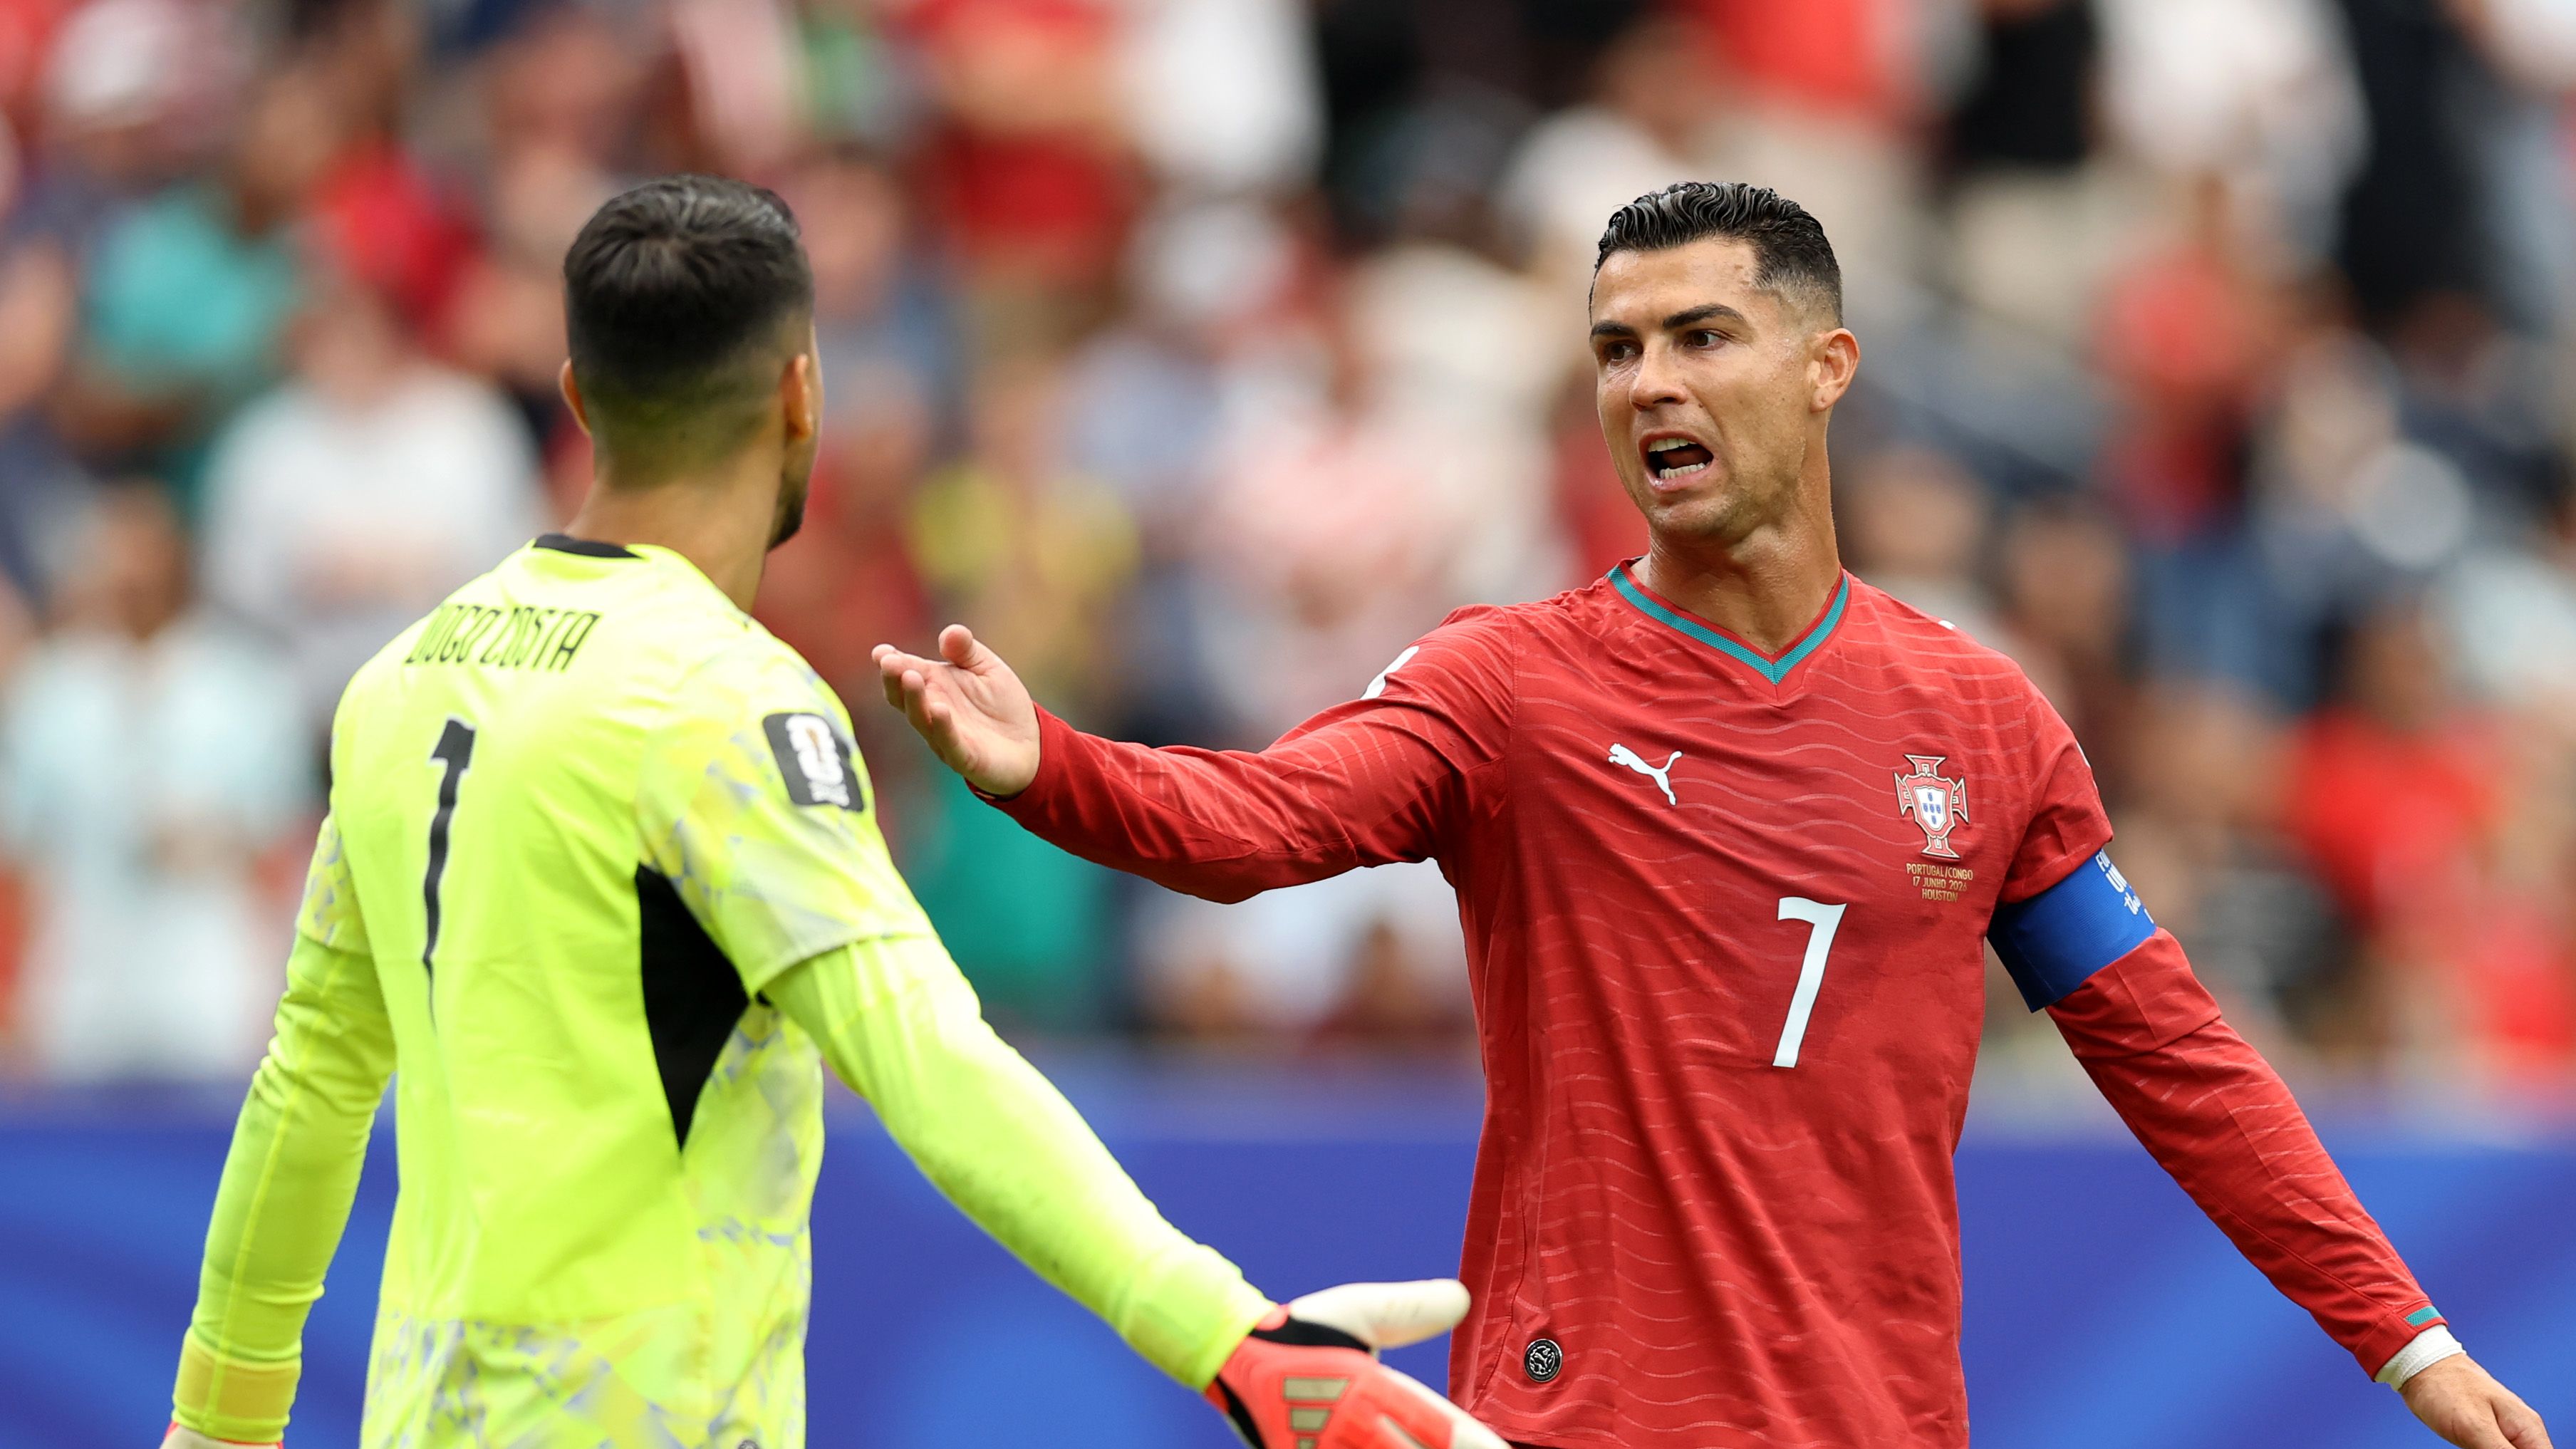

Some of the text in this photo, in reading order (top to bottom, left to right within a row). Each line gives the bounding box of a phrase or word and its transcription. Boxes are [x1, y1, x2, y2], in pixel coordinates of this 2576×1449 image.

[422, 719, 476, 1035] 1
[1906, 863, 1973, 881] PORTUGAL/CONGO
[1913, 876, 1967, 891] 17 JUNHO 2026
[1922, 888, 1958, 902] HOUSTON
[1772, 896, 1847, 1068] 7
